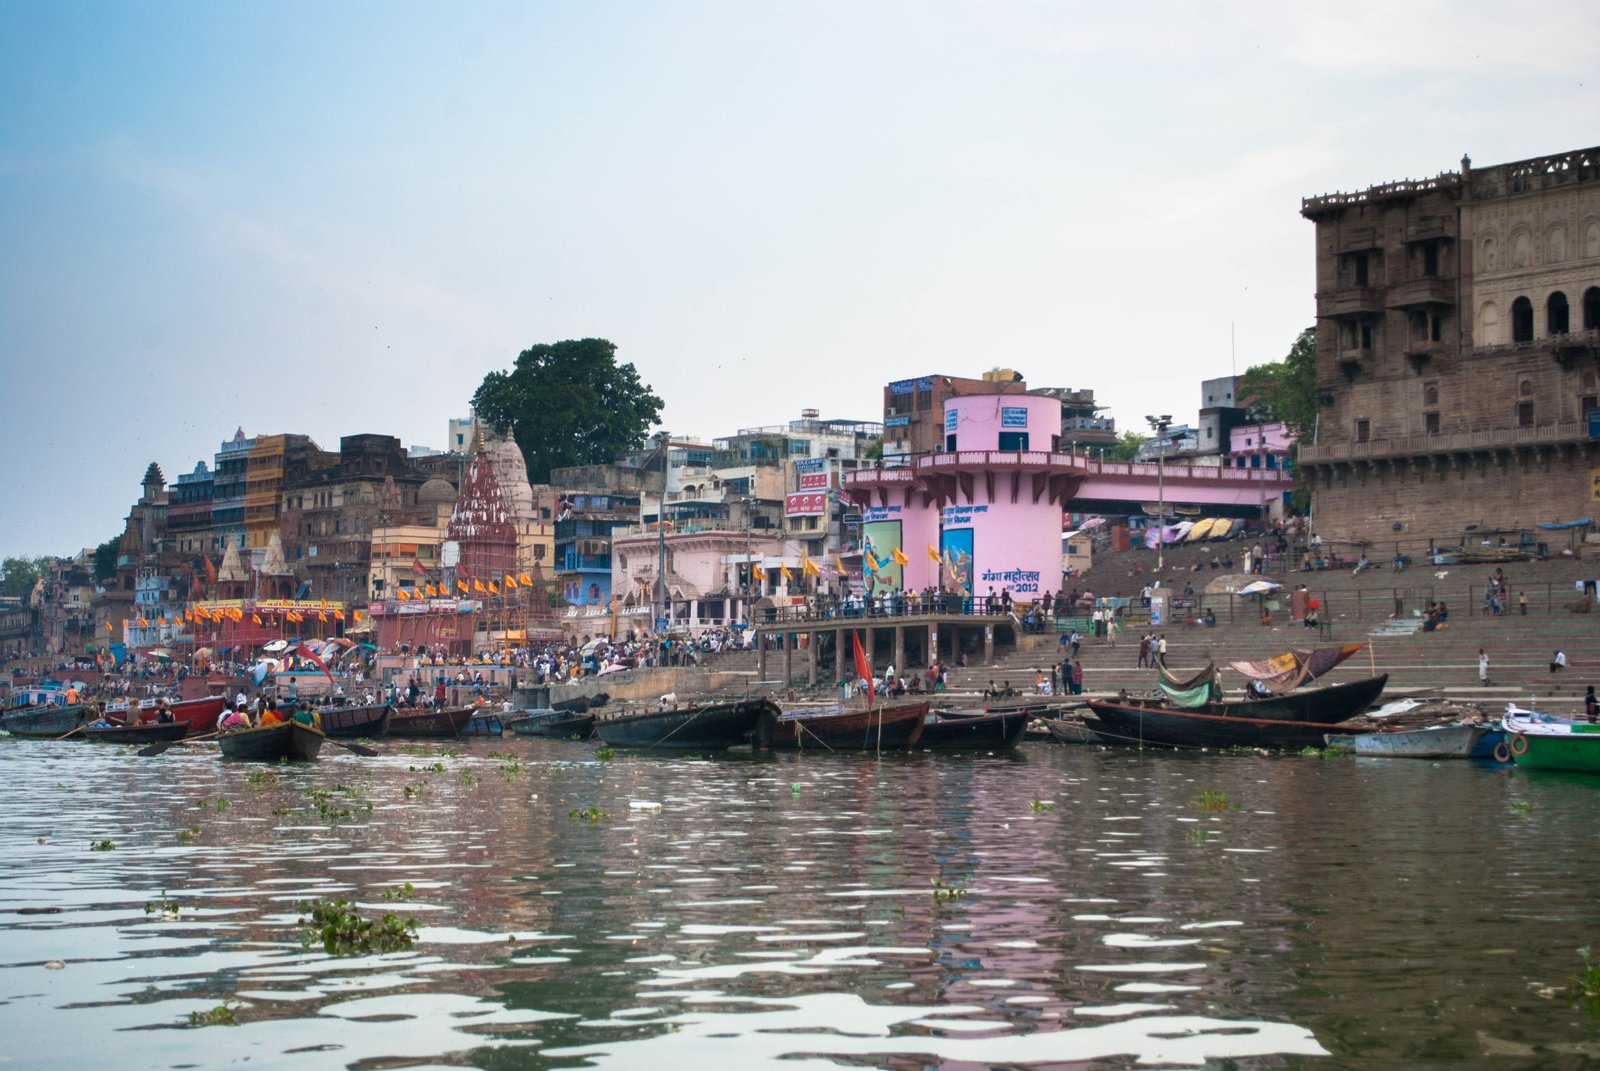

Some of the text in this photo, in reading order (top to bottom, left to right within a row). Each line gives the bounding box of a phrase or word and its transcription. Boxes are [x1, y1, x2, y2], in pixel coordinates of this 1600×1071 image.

[981, 568, 1040, 583] गंगा महोत्सव
[1016, 583, 1038, 592] 2012
